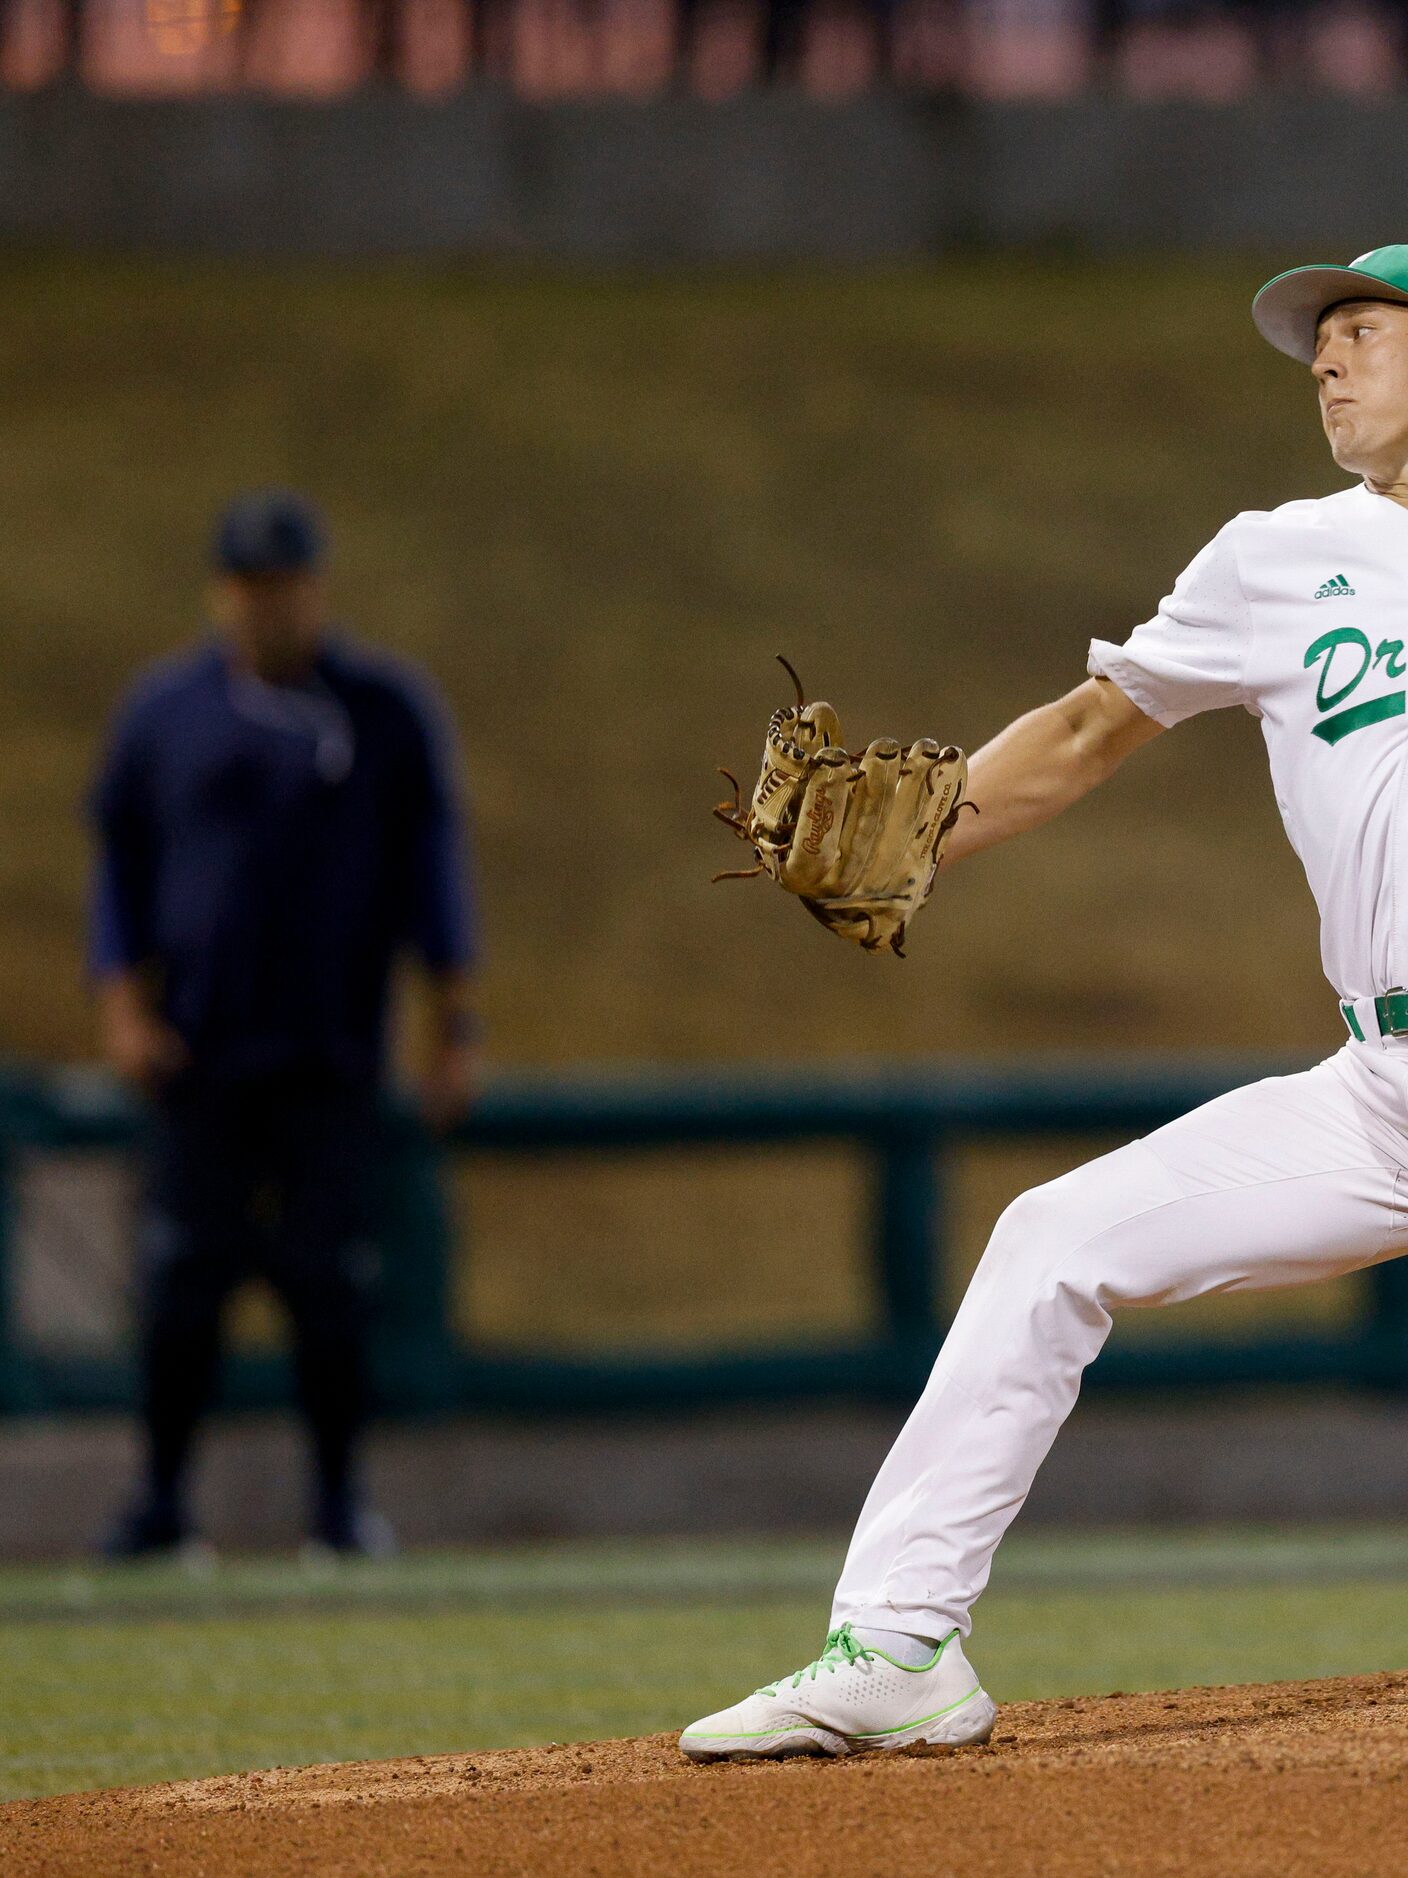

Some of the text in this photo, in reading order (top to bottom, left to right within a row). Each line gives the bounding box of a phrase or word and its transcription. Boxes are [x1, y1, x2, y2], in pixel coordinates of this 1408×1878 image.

[1314, 586, 1356, 599] adidas
[801, 785, 833, 855] Rawlings
[934, 796, 948, 822] GLOVE
[943, 782, 953, 796] CO.
